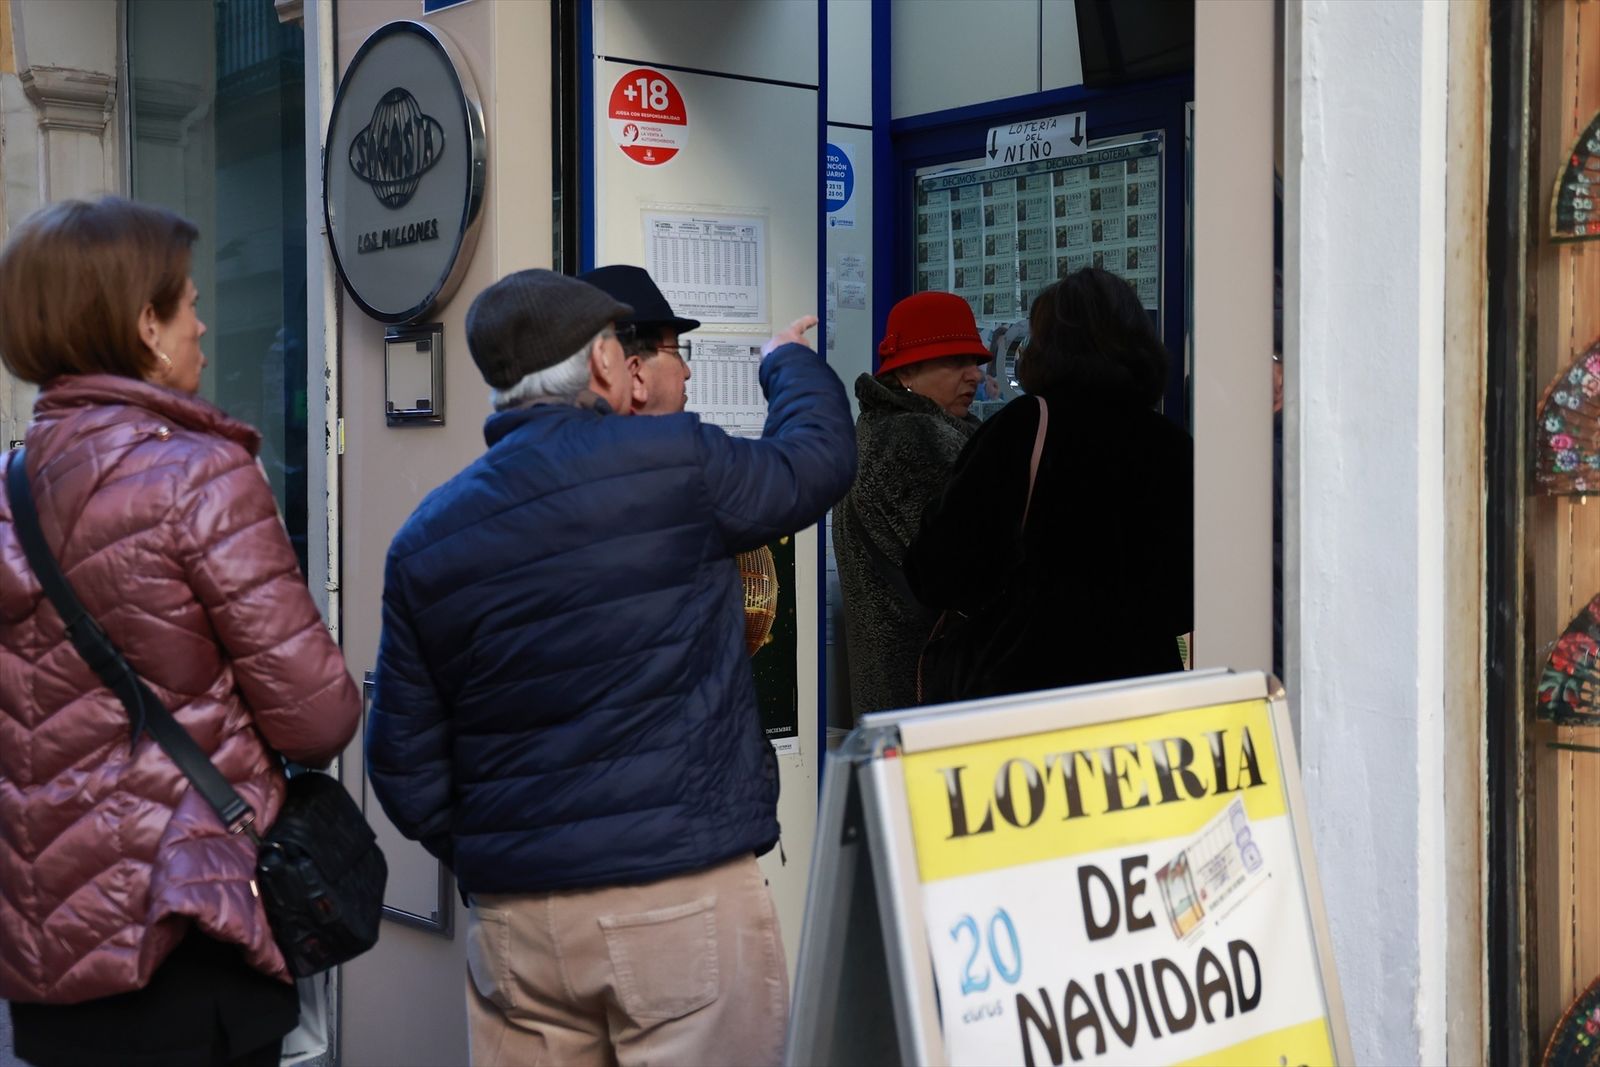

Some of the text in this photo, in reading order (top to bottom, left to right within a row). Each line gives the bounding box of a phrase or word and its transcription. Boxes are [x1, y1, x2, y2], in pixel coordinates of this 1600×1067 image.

[624, 78, 669, 111] +18
[641, 112, 680, 120] RESPONSABILIDAD
[1004, 141, 1052, 163] NIÑO
[1025, 133, 1043, 142] DEL
[357, 218, 439, 254] LOS MILLONES
[765, 726, 792, 734] DICIEMBRE
[938, 726, 1267, 840] LOTERIA
[1077, 854, 1156, 942] DE
[950, 907, 1022, 994] 20
[1015, 939, 1262, 1067] NAVIDAD
